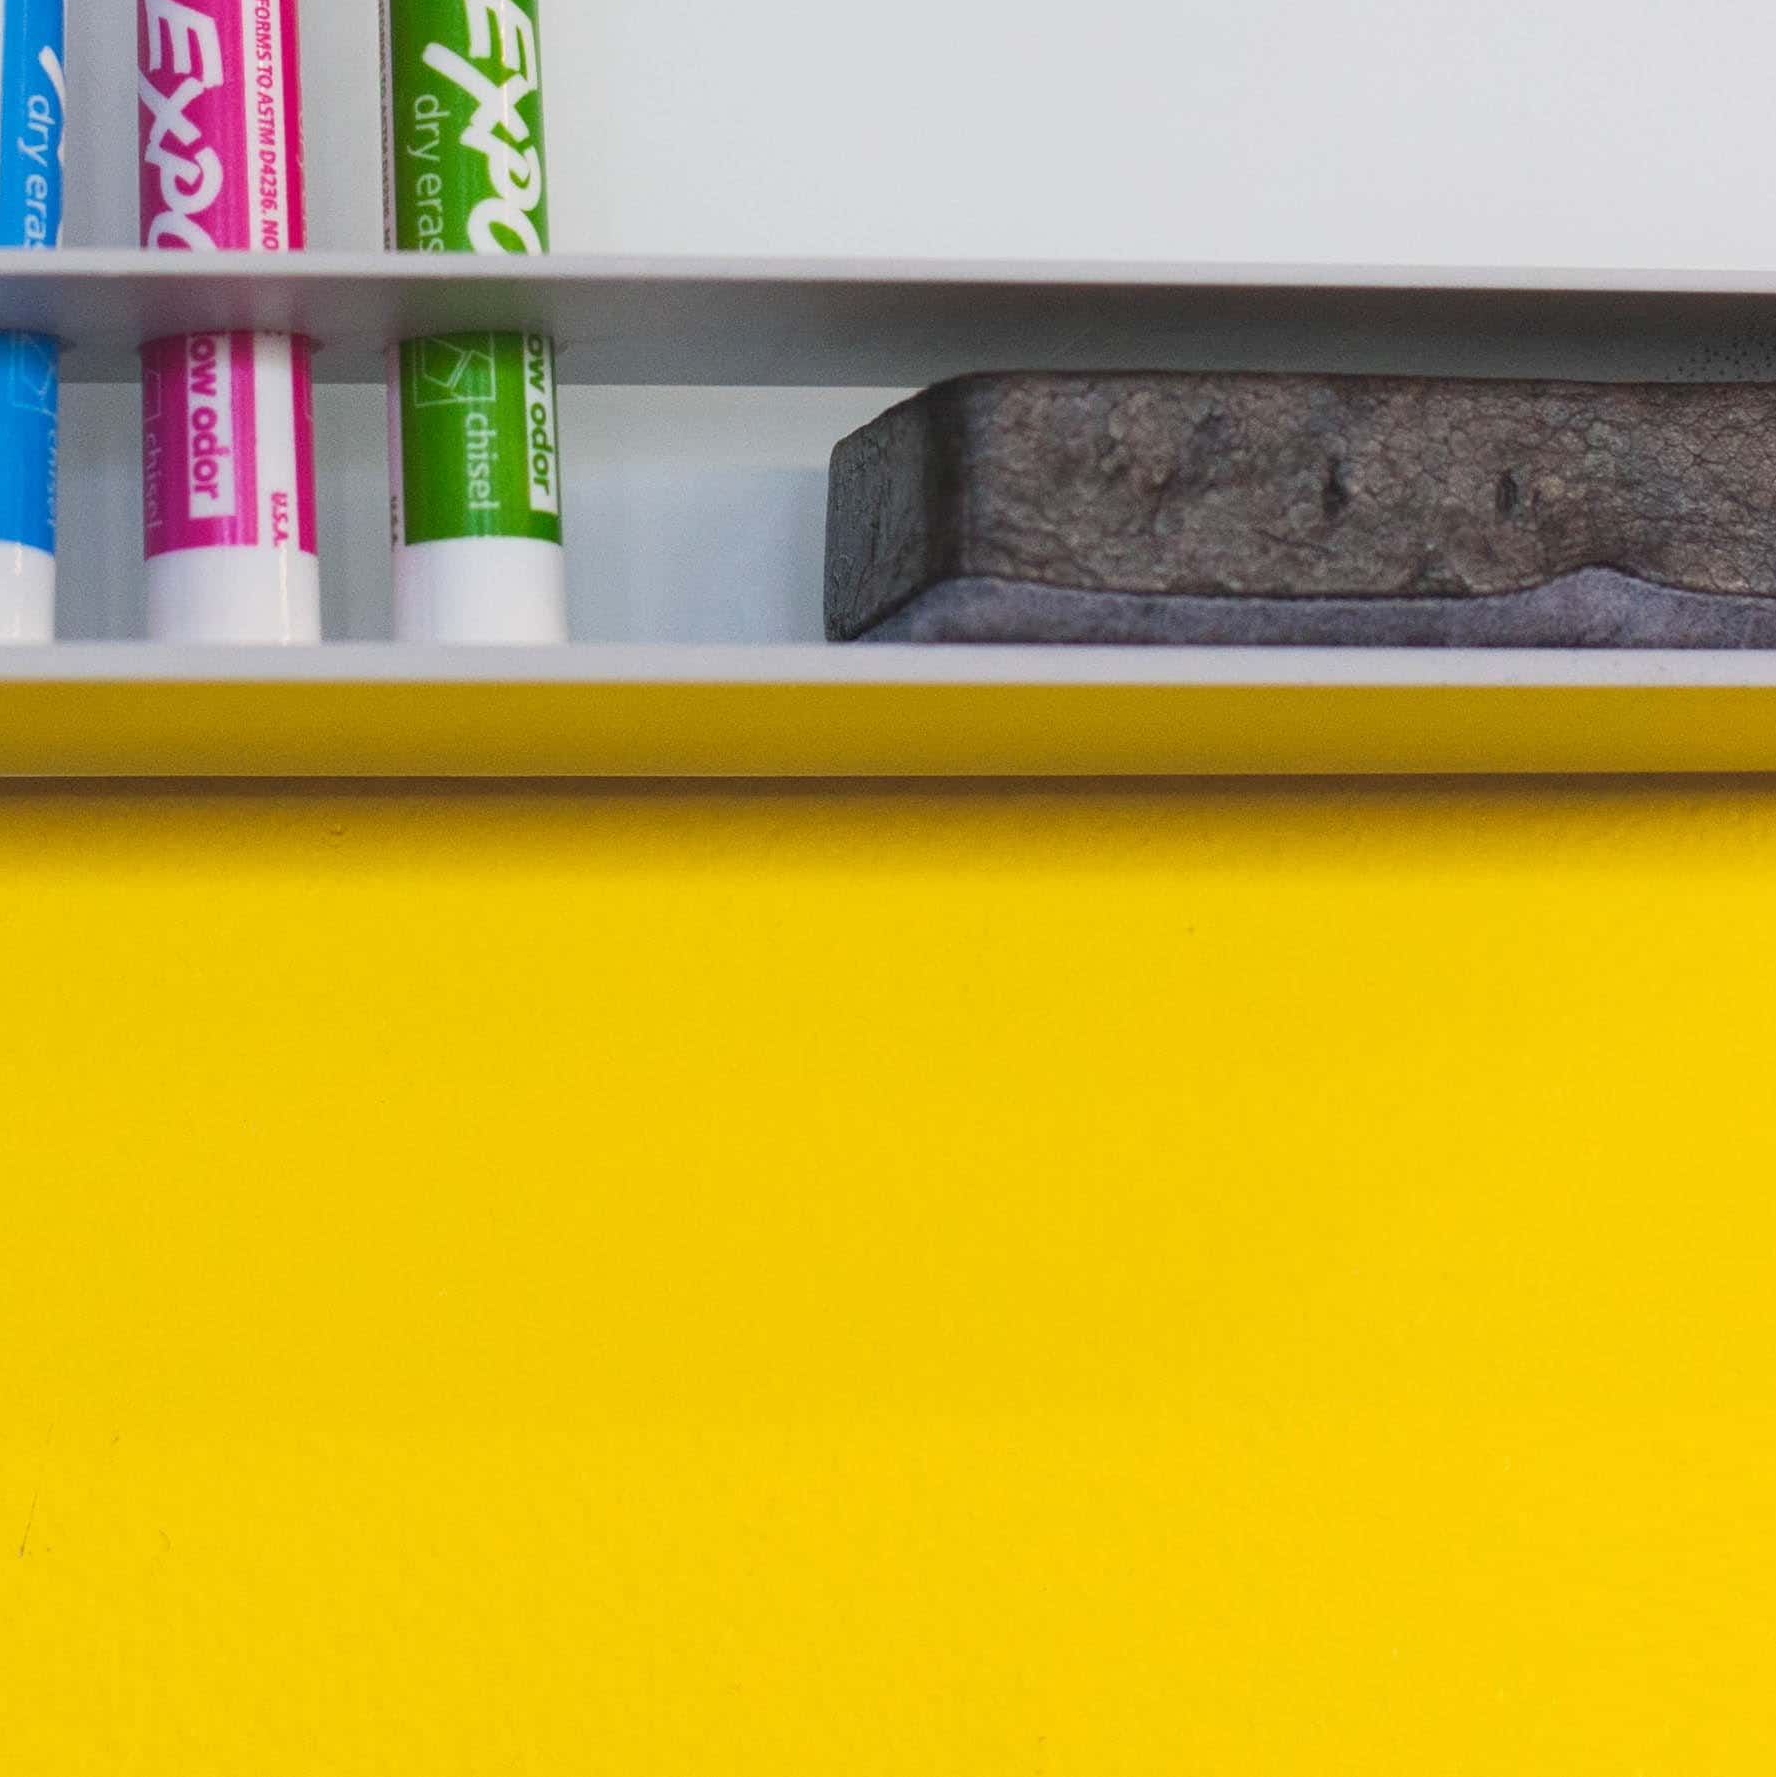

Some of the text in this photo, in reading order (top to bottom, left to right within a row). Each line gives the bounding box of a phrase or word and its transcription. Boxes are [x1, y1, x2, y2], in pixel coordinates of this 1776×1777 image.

[256, 65, 274, 89] TO
[258, 91, 276, 145] ASTM
[16, 94, 55, 247] dry eras
[259, 150, 278, 214] D4236.
[406, 94, 451, 252] dry eras
[192, 407, 232, 499] odor
[465, 412, 500, 510] chisel
[531, 403, 554, 496] odor
[270, 491, 289, 548] U.S.A.
